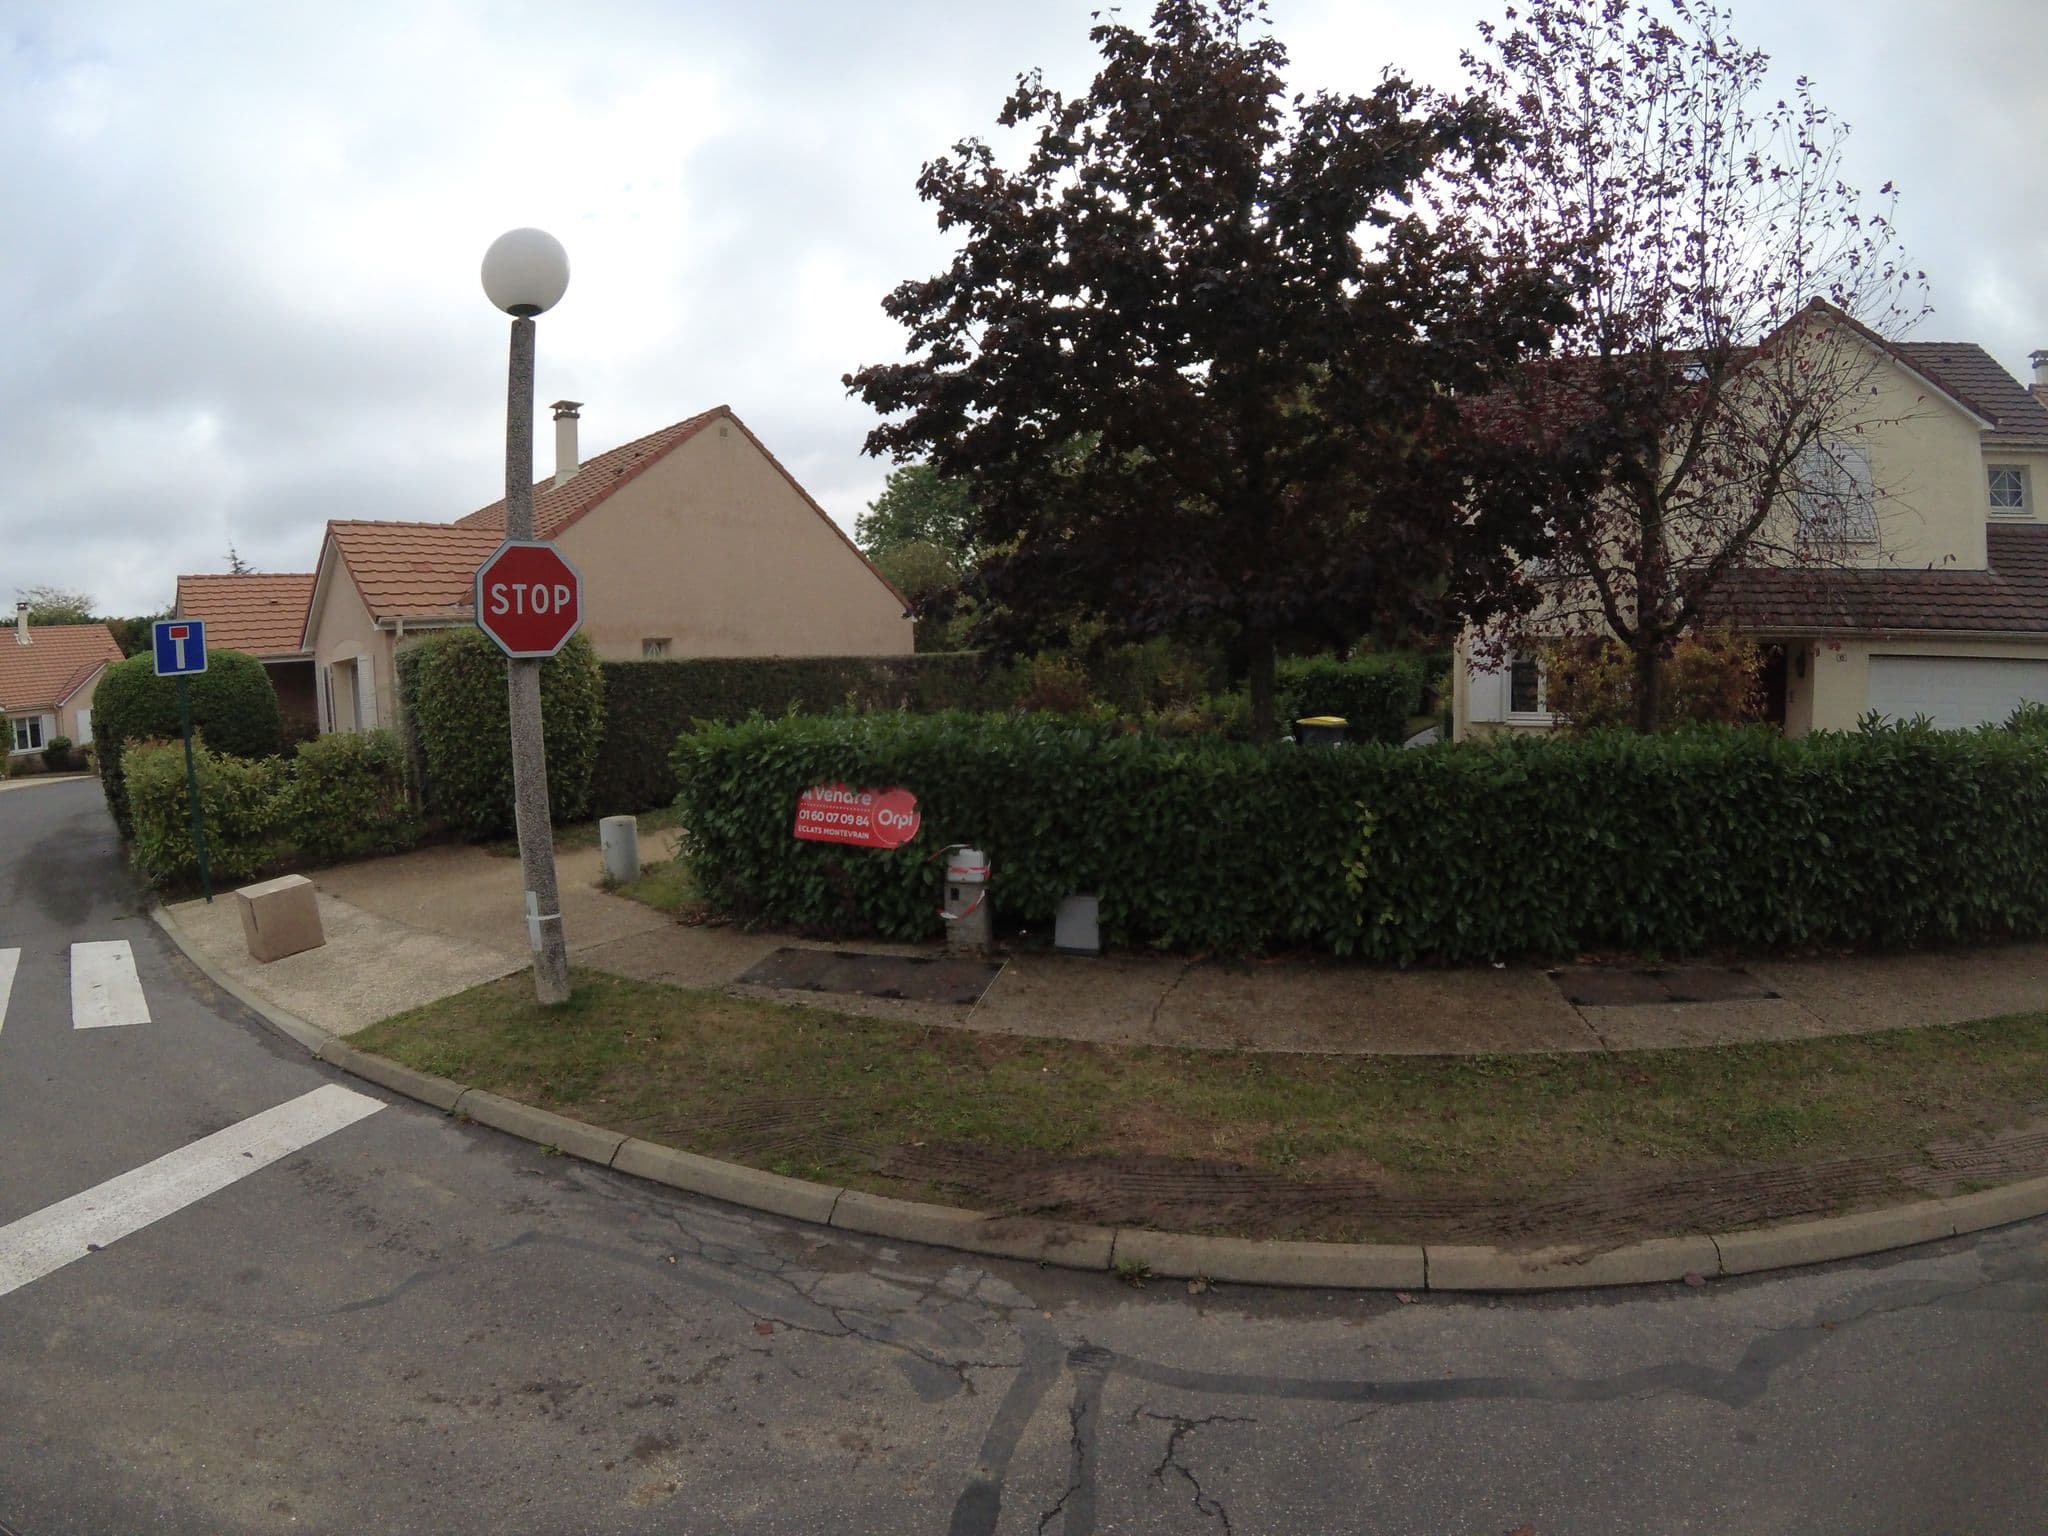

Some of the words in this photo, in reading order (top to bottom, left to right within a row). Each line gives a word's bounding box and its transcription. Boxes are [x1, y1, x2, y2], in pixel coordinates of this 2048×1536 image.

[490, 583, 571, 615] STOP
[799, 810, 810, 820] 01
[811, 811, 824, 822] 60
[826, 813, 839, 823] 07
[840, 814, 854, 824] 09
[856, 816, 870, 827] 84
[878, 809, 913, 829] Orpi
[798, 825, 822, 834] ECLATS
[823, 828, 870, 839] MONTEVRAIN
